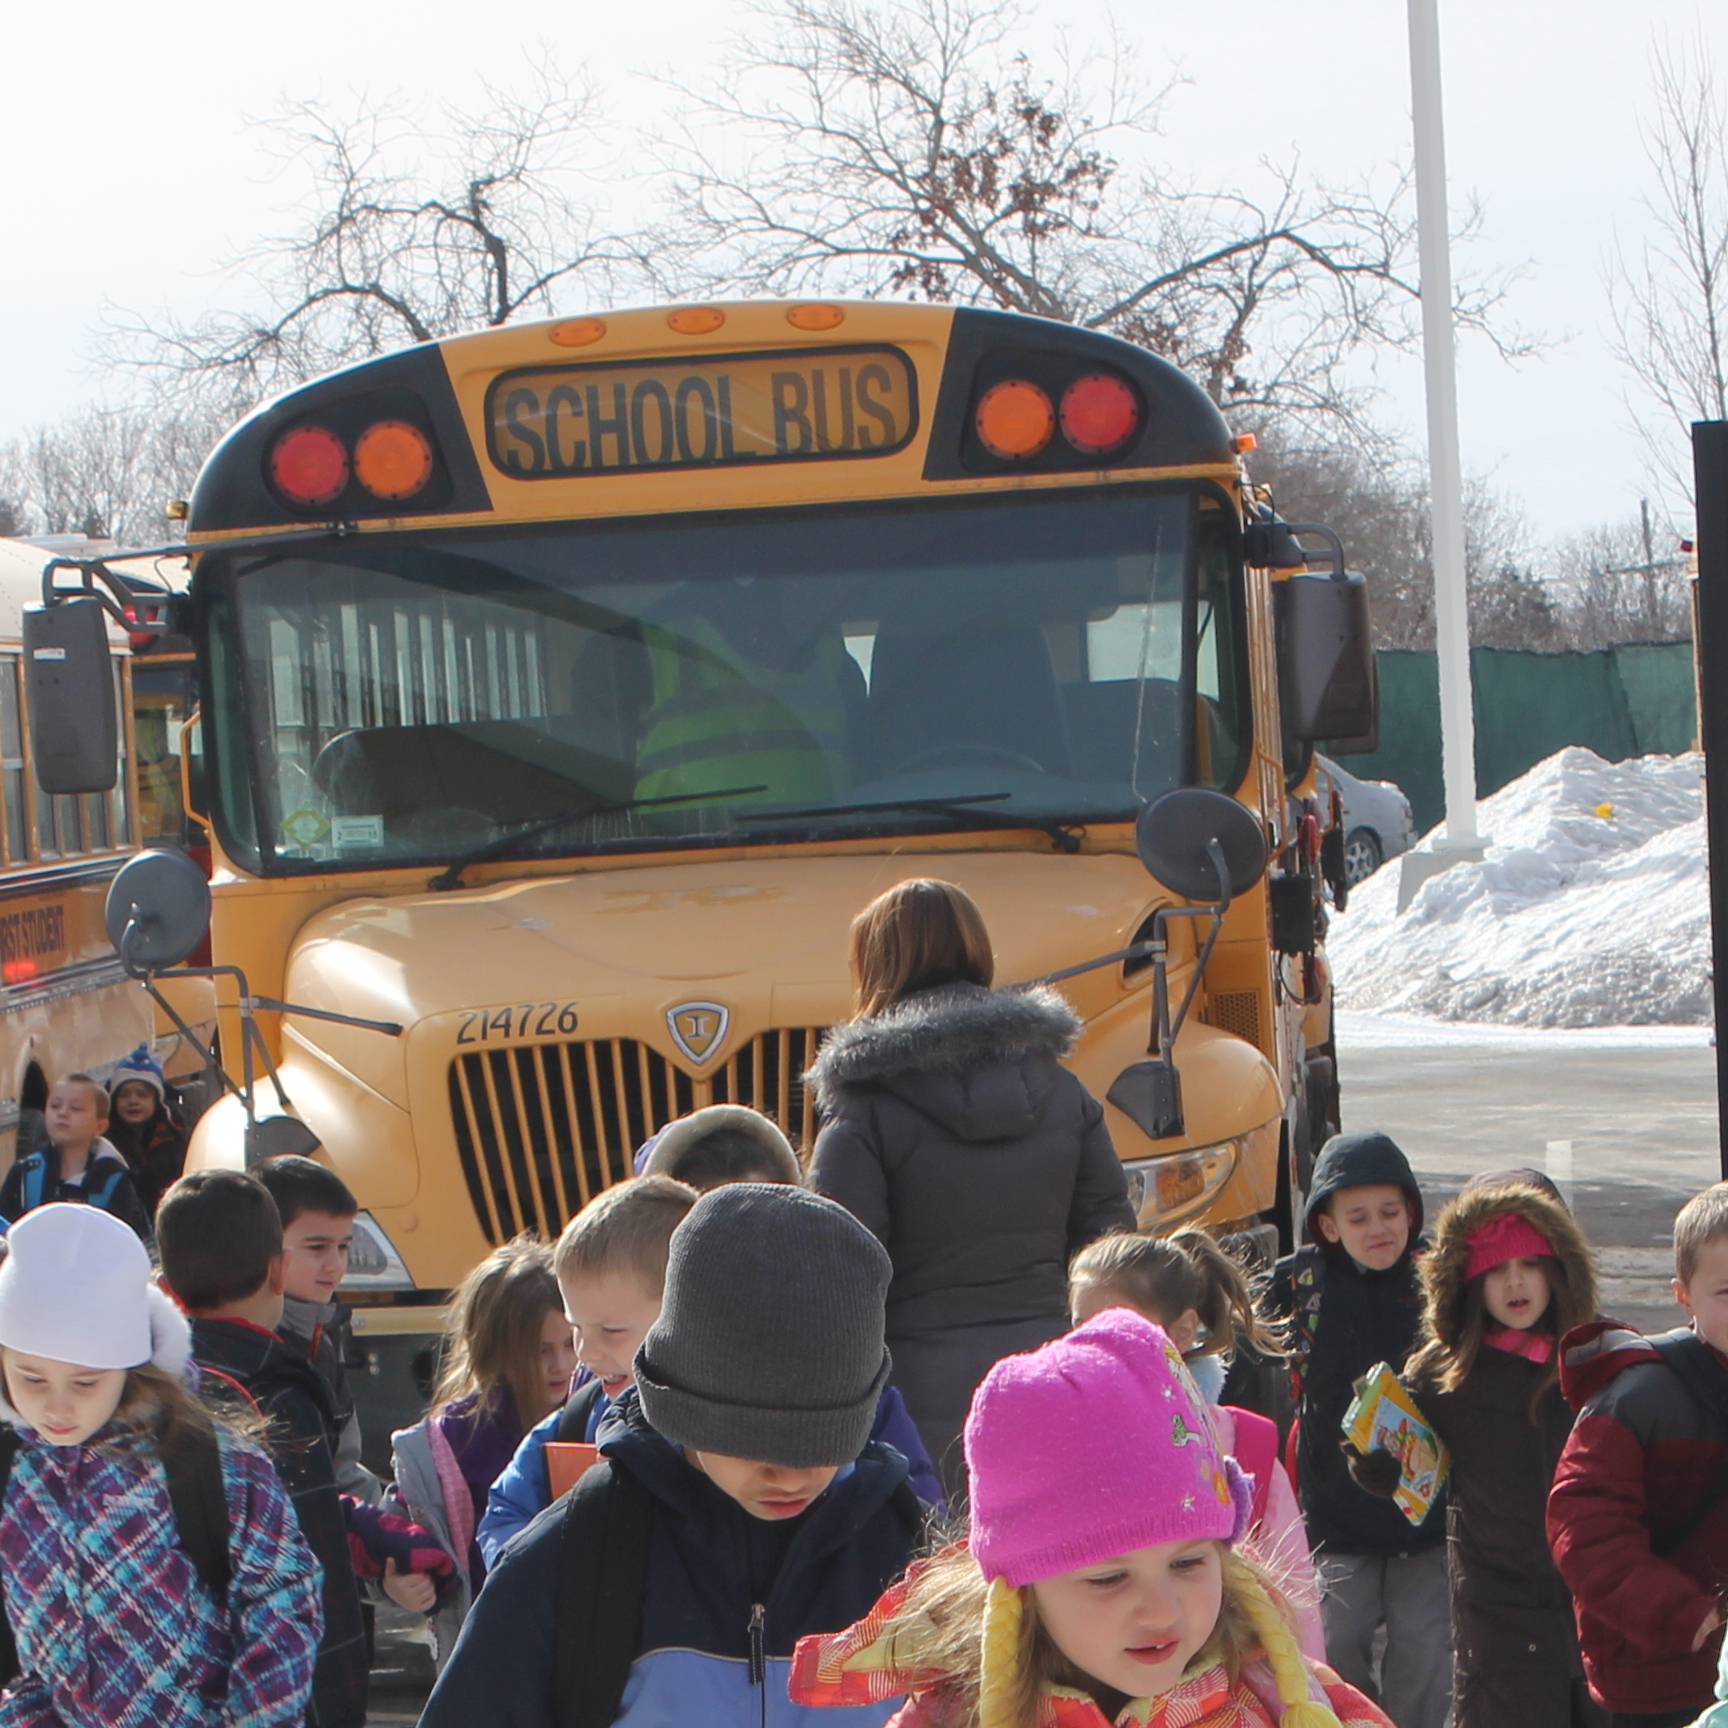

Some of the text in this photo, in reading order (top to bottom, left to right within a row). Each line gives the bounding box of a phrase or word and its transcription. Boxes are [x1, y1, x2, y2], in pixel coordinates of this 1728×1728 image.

[504, 363, 897, 472] SCHOOL BUS
[456, 1001, 579, 1045] 214726
